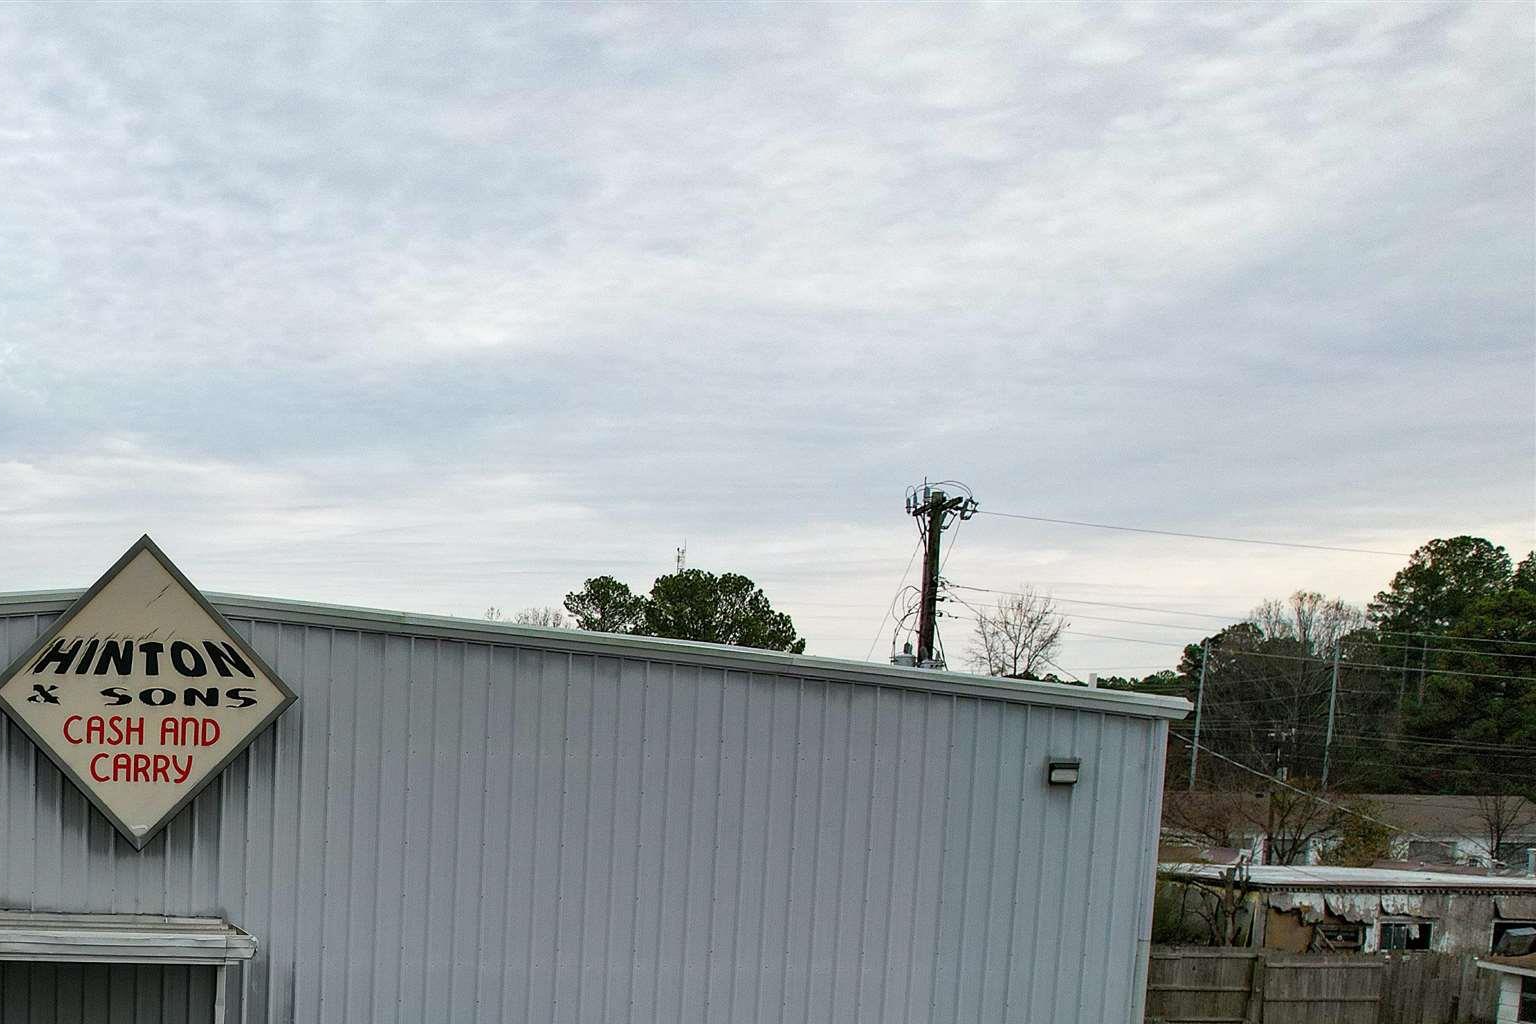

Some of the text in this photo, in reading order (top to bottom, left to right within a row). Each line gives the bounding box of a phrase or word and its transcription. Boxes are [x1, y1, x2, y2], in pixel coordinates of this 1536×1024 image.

[33, 639, 255, 679] HINTON
[100, 687, 258, 708] SONS
[64, 715, 221, 747] CASH AND
[90, 753, 193, 784] CARRY
